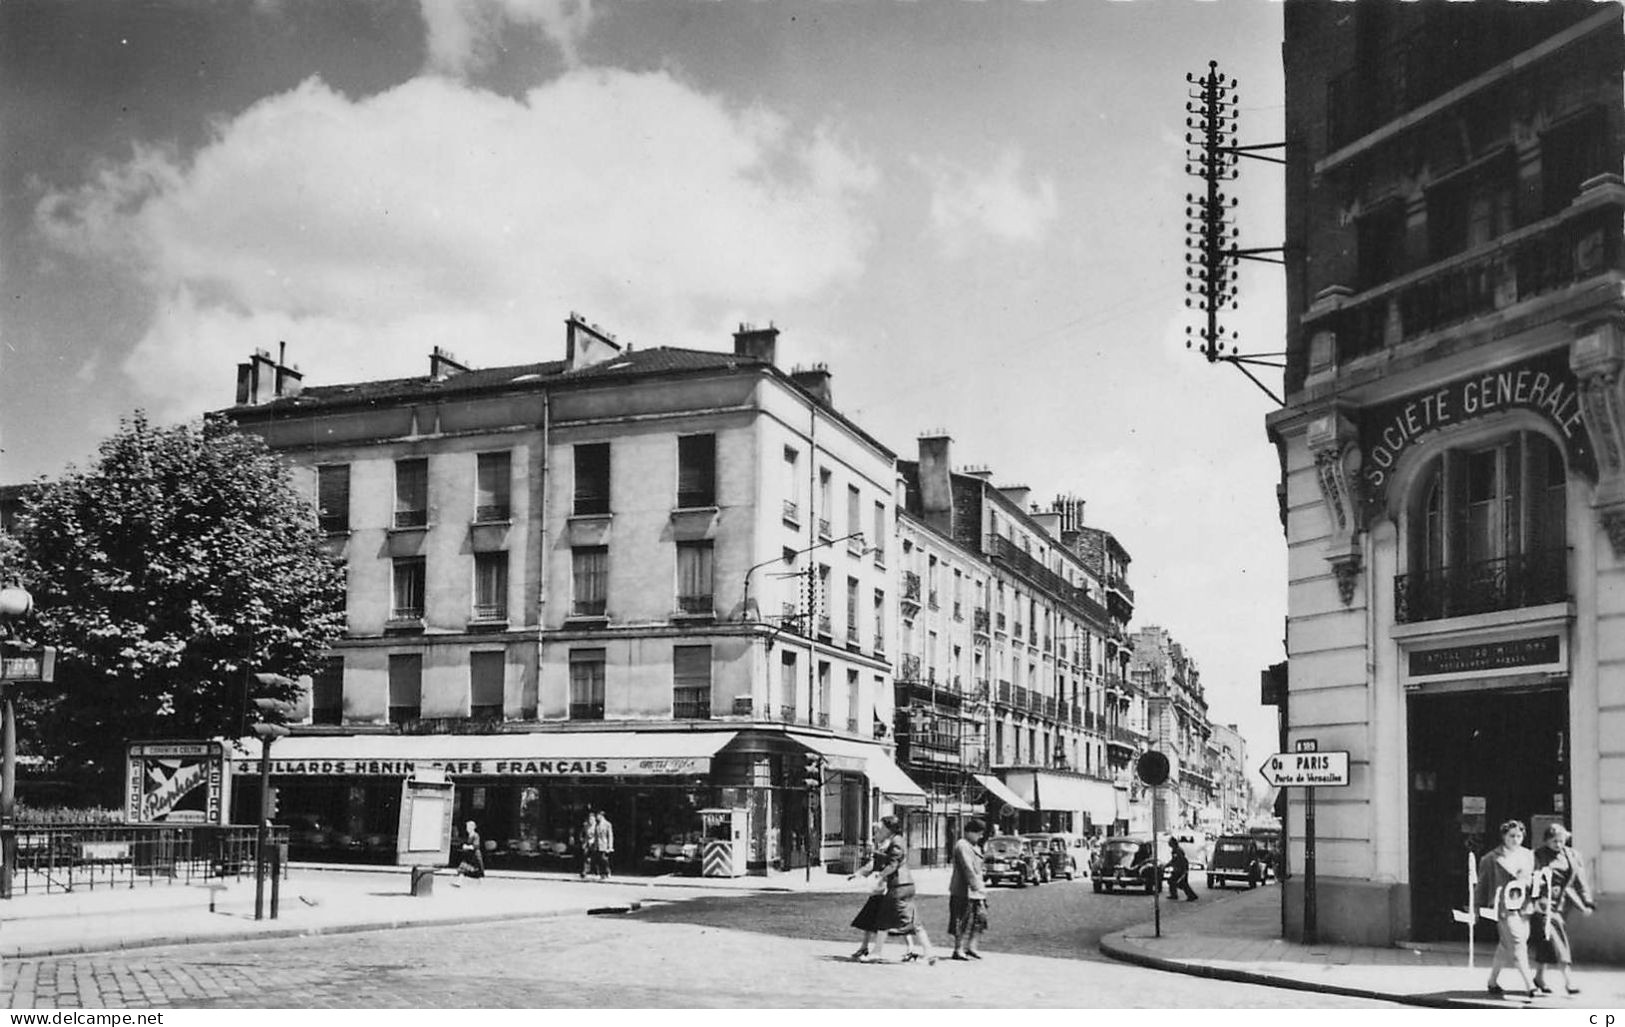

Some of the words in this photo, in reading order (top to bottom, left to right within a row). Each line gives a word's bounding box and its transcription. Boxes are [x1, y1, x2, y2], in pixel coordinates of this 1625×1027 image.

[238, 762, 250, 774] 4
[496, 760, 608, 775] FRANÇAIS
[1296, 756, 1329, 770] PARIS
[1274, 773, 1293, 783] Porte
[1296, 773, 1305, 783] de
